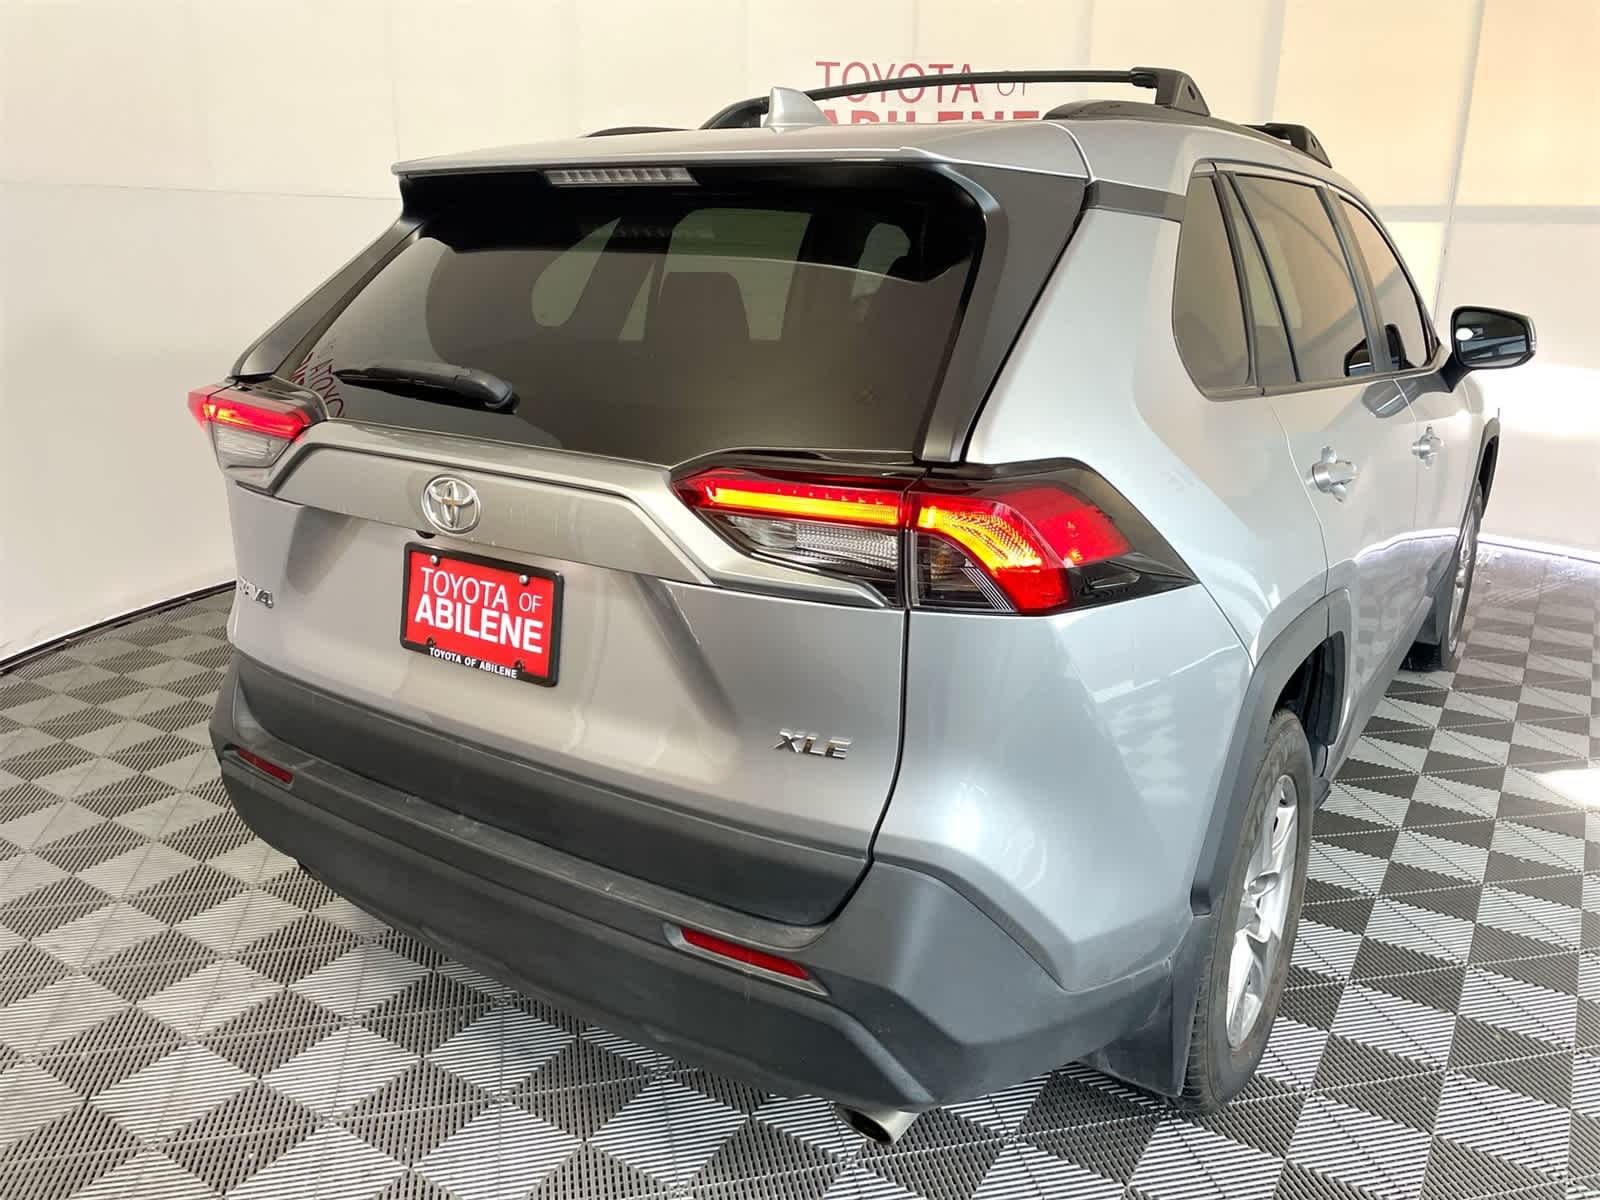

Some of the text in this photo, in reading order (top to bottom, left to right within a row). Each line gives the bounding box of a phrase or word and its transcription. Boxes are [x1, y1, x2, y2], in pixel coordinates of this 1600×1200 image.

[815, 61, 979, 104] TOYOTA
[421, 567, 543, 613] TOYOTA OF
[414, 594, 543, 654] ABILENE
[429, 647, 518, 679] TOYOTA OF ABILENE
[774, 728, 853, 760] XLE
